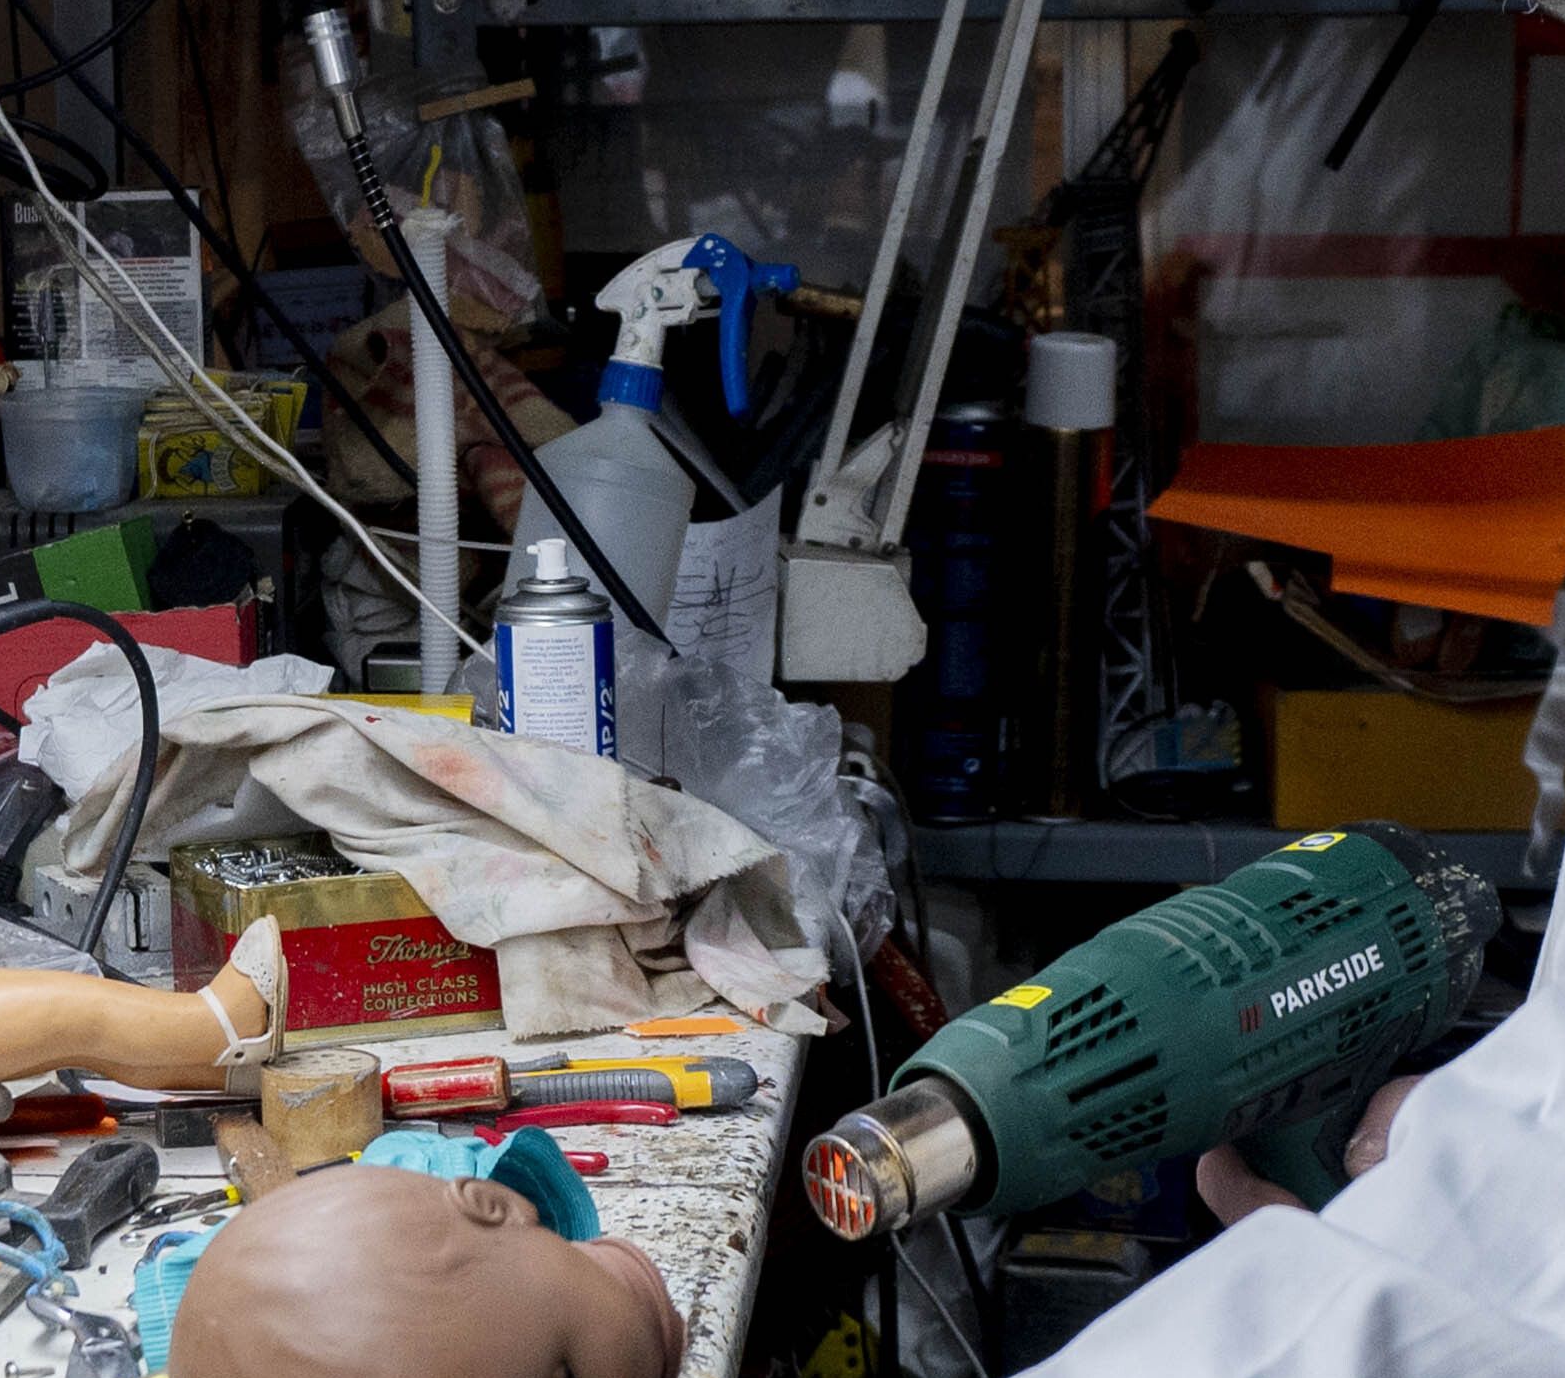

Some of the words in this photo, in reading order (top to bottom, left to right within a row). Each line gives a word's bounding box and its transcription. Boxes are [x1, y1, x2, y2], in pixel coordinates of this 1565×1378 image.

[363, 982, 407, 998] HIGH
[416, 974, 479, 991] CLASS
[1270, 944, 1386, 1019] PARKSIDE
[363, 990, 479, 1011] CONFECTIONS
